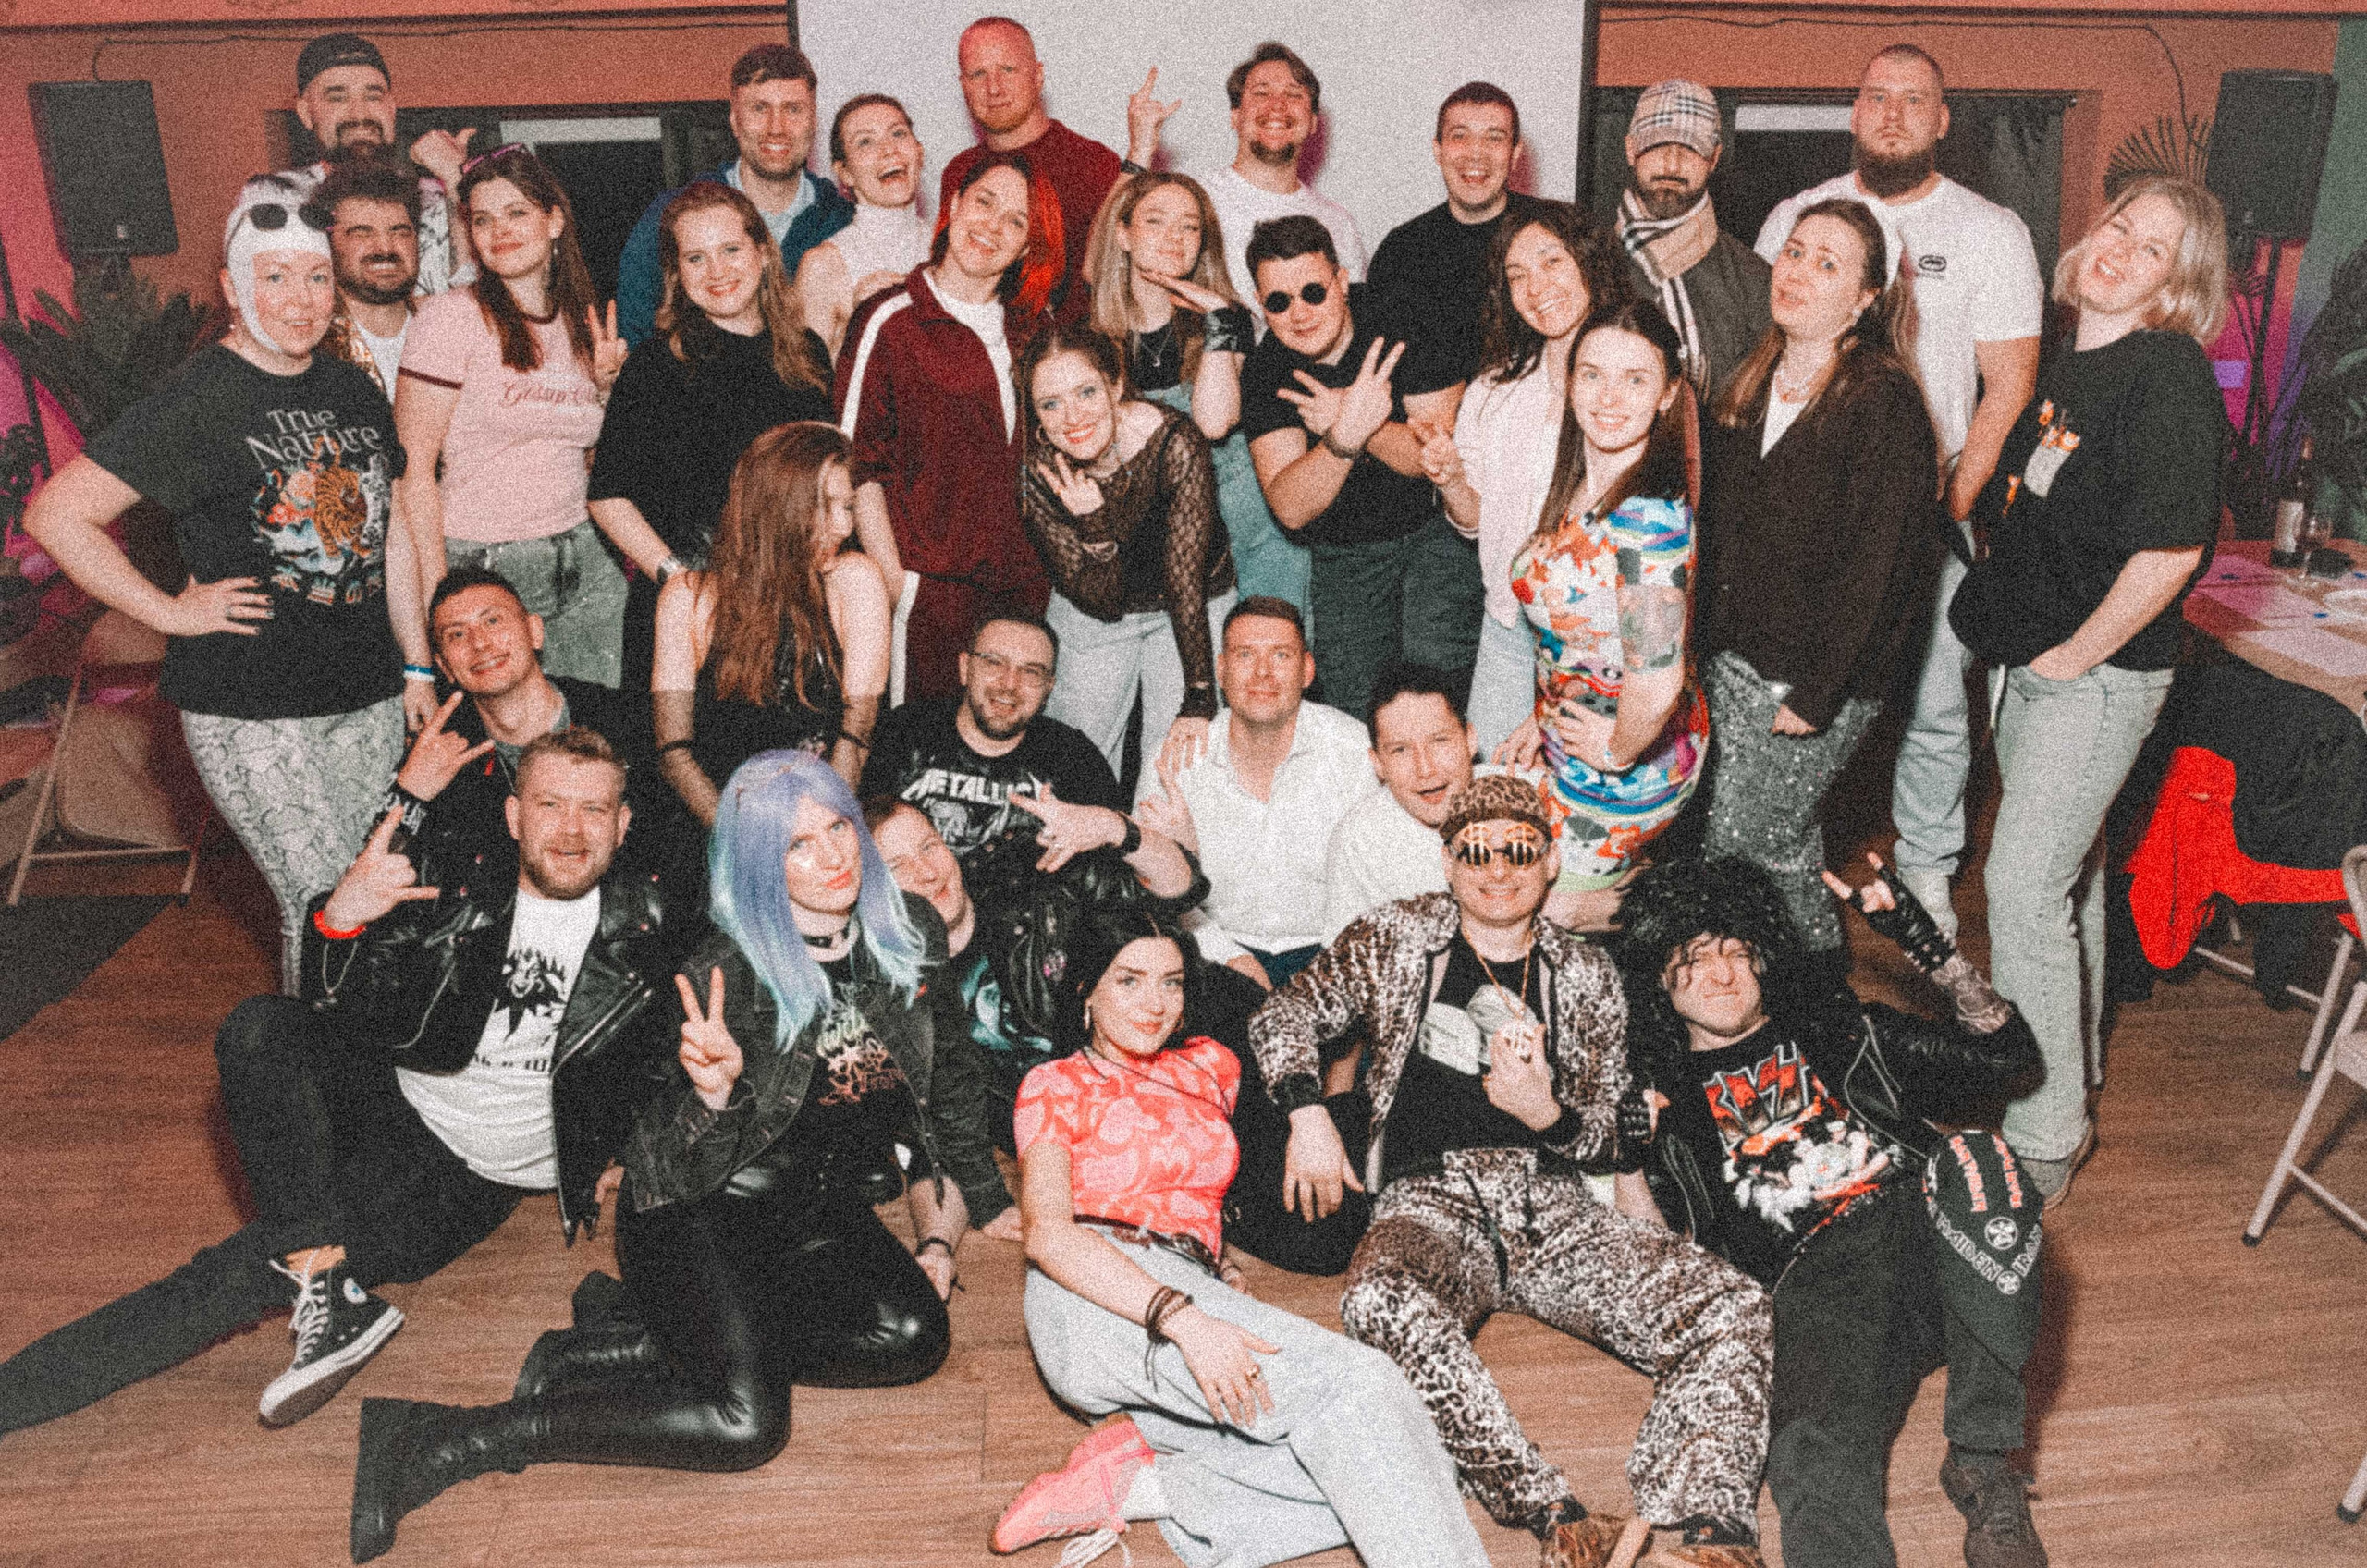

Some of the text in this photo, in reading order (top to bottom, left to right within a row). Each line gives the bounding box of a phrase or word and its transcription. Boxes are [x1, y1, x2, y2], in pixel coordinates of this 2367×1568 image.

[245, 425, 383, 470] Nature
[267, 409, 337, 435] True
[1701, 1040, 1810, 1156] KIS
[1936, 1211, 2004, 1282] MAIDEN
